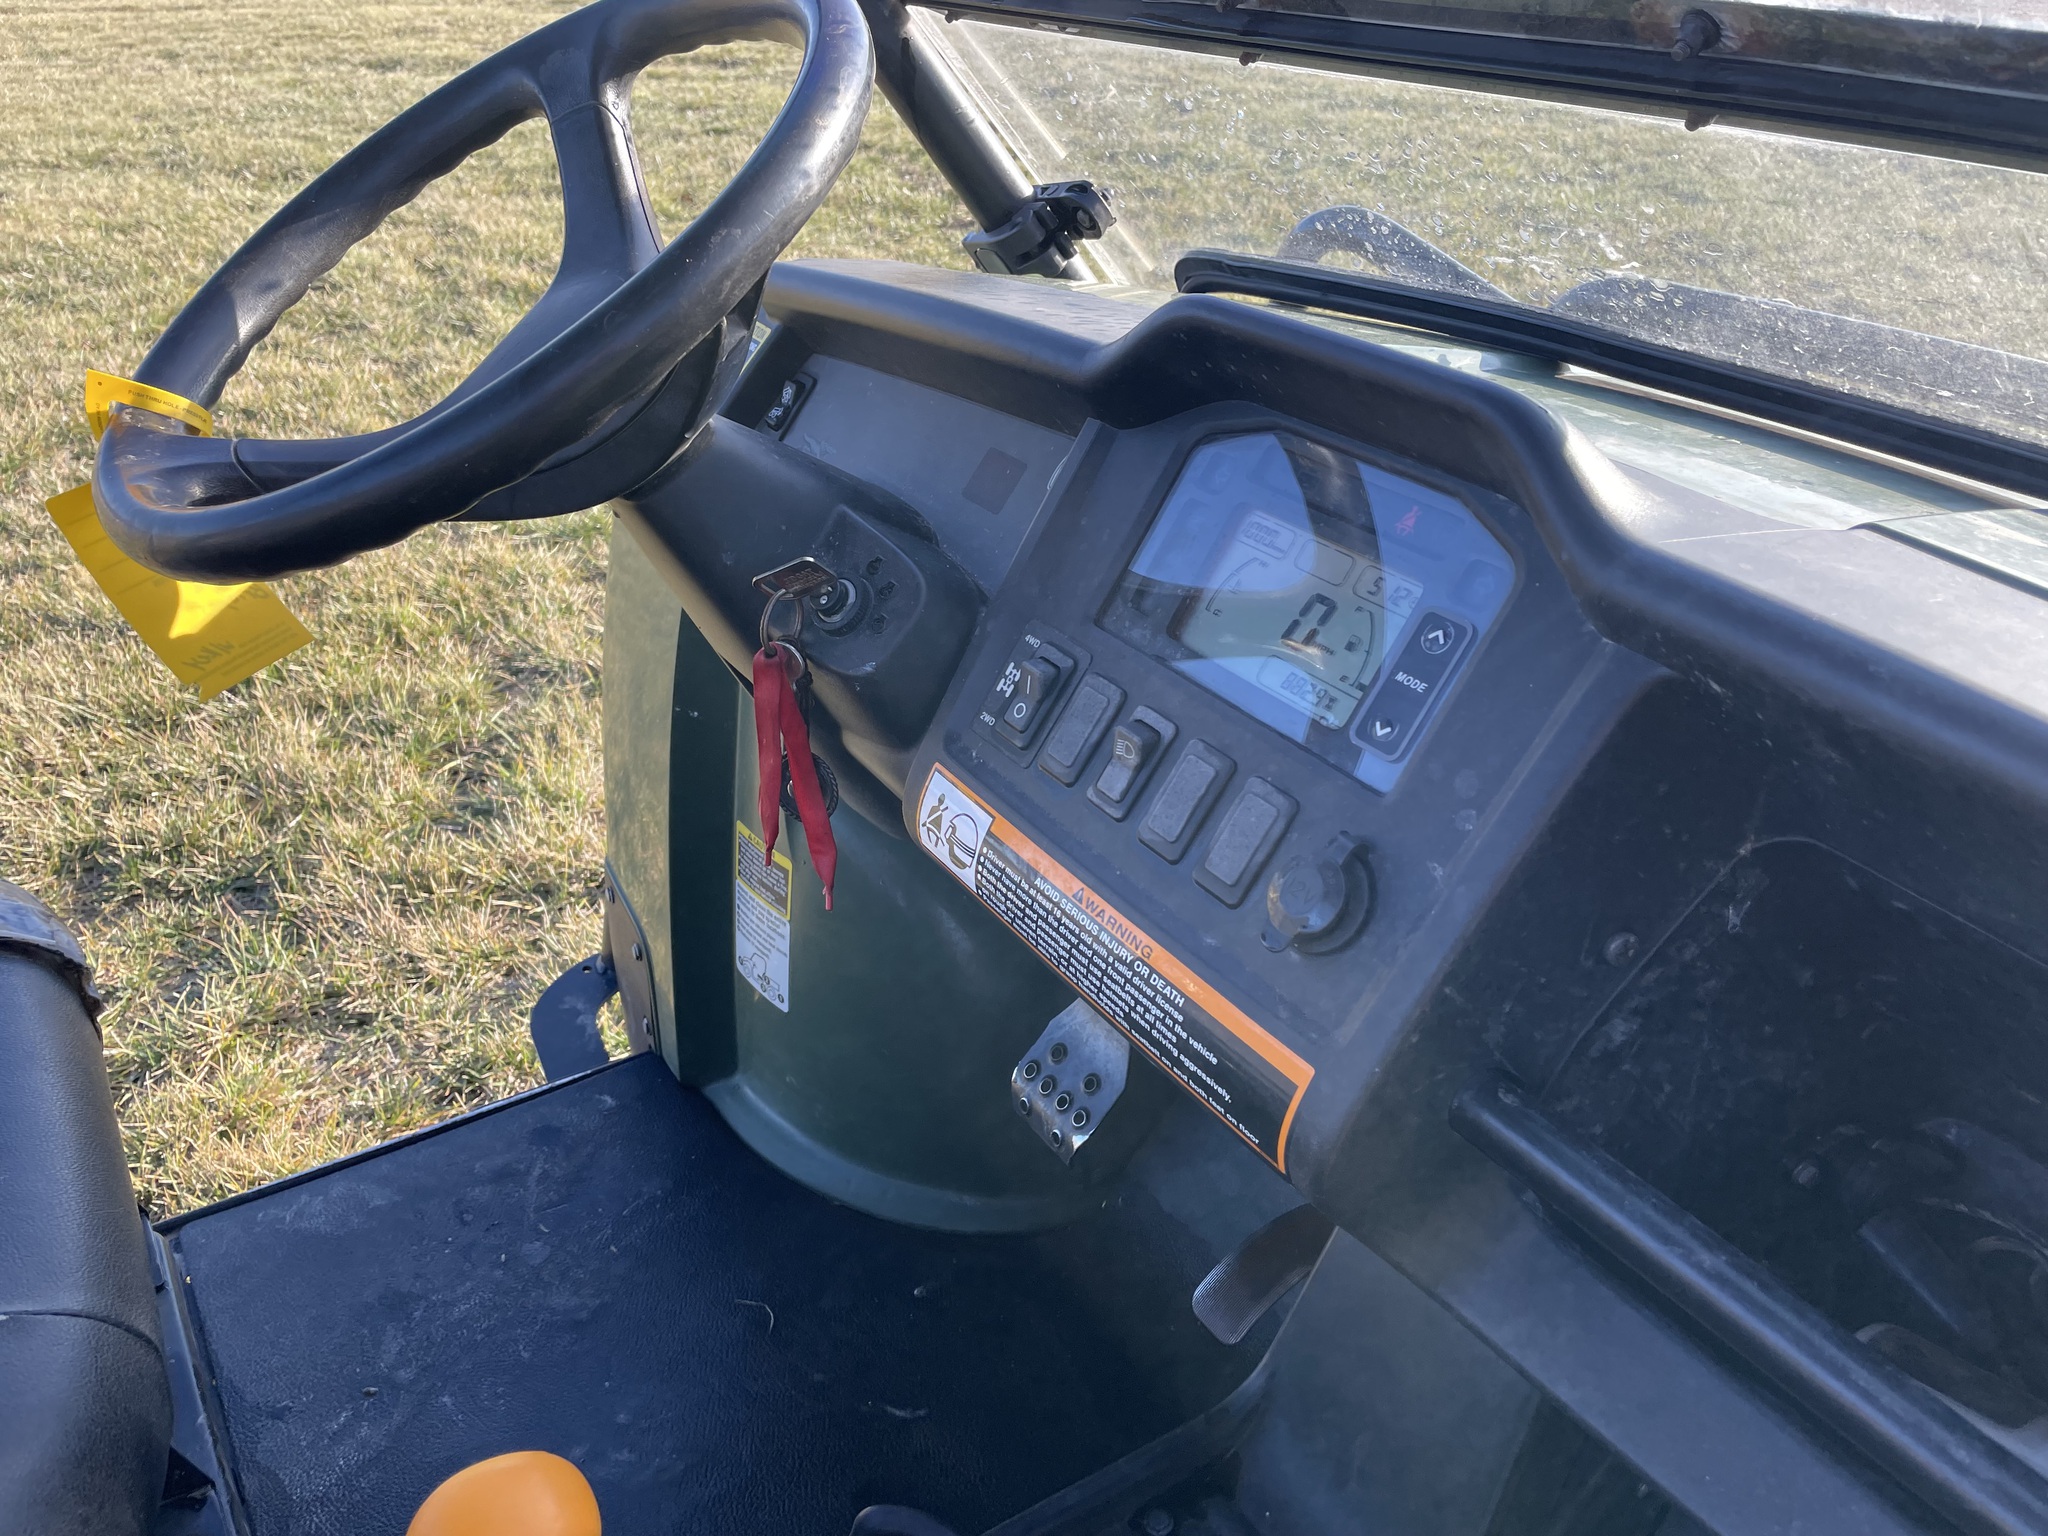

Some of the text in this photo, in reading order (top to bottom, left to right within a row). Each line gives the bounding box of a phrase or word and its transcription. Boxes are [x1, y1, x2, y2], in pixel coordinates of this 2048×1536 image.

[1025, 634, 1041, 648] 4WD
[1394, 671, 1429, 693] MODE
[980, 711, 996, 726] 2WD
[1287, 876, 1317, 905] 12V
[986, 849, 1183, 1022] Driver must be at least 16 years old with a valid driver license
[1034, 877, 1184, 1007] AVOID SERIOUS INJURY OR DEATH
[1085, 897, 1153, 961] WARNING
[981, 868, 1176, 1043] Both the driver and passenger must use seatbelts at all times
[984, 858, 1217, 1064] Never have more than the driver and one front passenger in the vehicle
[1239, 1123, 1259, 1144] floor
